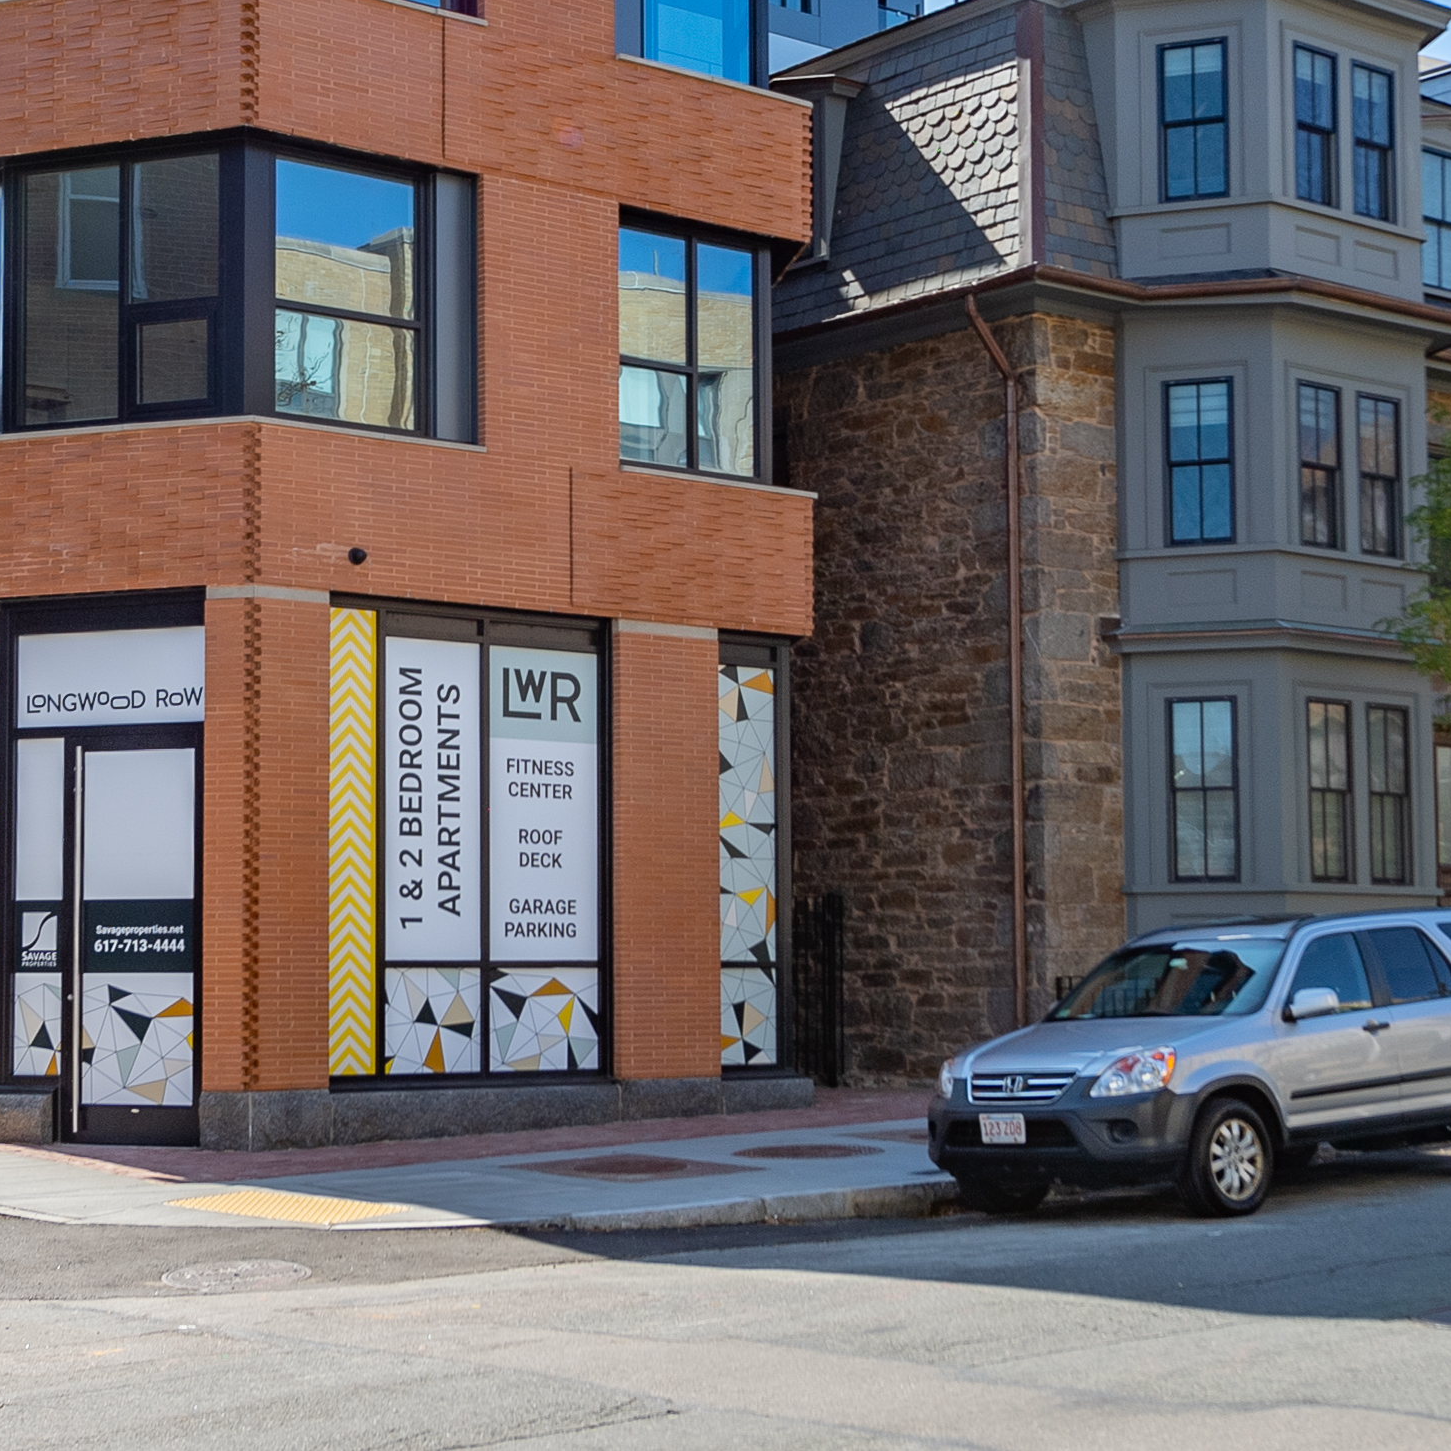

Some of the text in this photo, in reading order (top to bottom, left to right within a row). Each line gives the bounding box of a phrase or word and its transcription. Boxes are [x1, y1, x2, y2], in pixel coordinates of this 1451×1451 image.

[502, 667, 582, 723] LWR
[506, 758, 574, 777] FITNESS
[398, 667, 423, 929] 1 & 2 BEDROOM
[508, 782, 573, 800] CENTER
[437, 683, 461, 917] APARTMENTS
[518, 828, 563, 845] ROOF
[519, 852, 563, 869] DECK
[508, 898, 577, 915] GARAGE
[95, 924, 184, 937] Savageproperties.net
[504, 922, 577, 938] PARKING
[94, 938, 185, 952] 617-713-4444
[21, 951, 57, 961] SAVAGE
